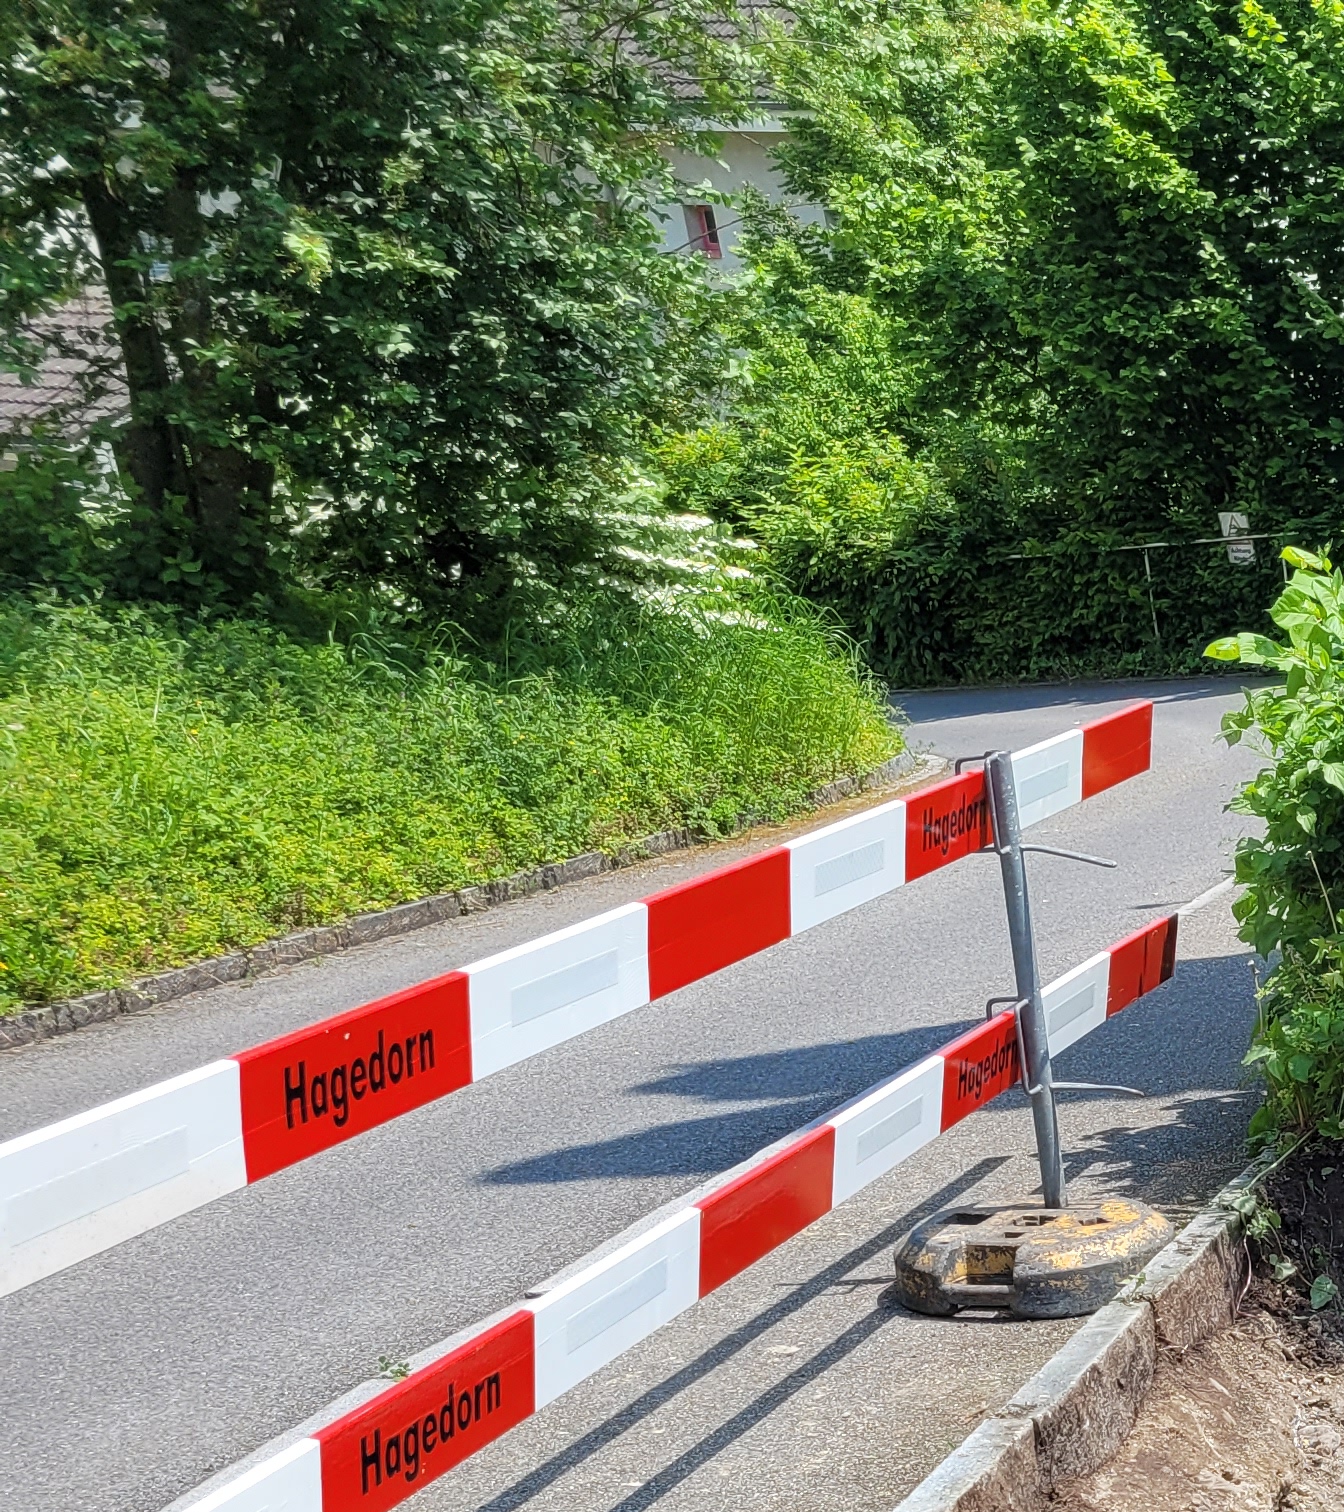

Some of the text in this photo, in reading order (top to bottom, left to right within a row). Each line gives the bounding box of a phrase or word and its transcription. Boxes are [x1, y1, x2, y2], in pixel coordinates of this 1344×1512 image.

[923, 792, 987, 856] Hagedorn
[284, 1028, 434, 1129] Hagedorn
[957, 1037, 1019, 1101] Hagedorn
[360, 1372, 501, 1492] Hagedorn
